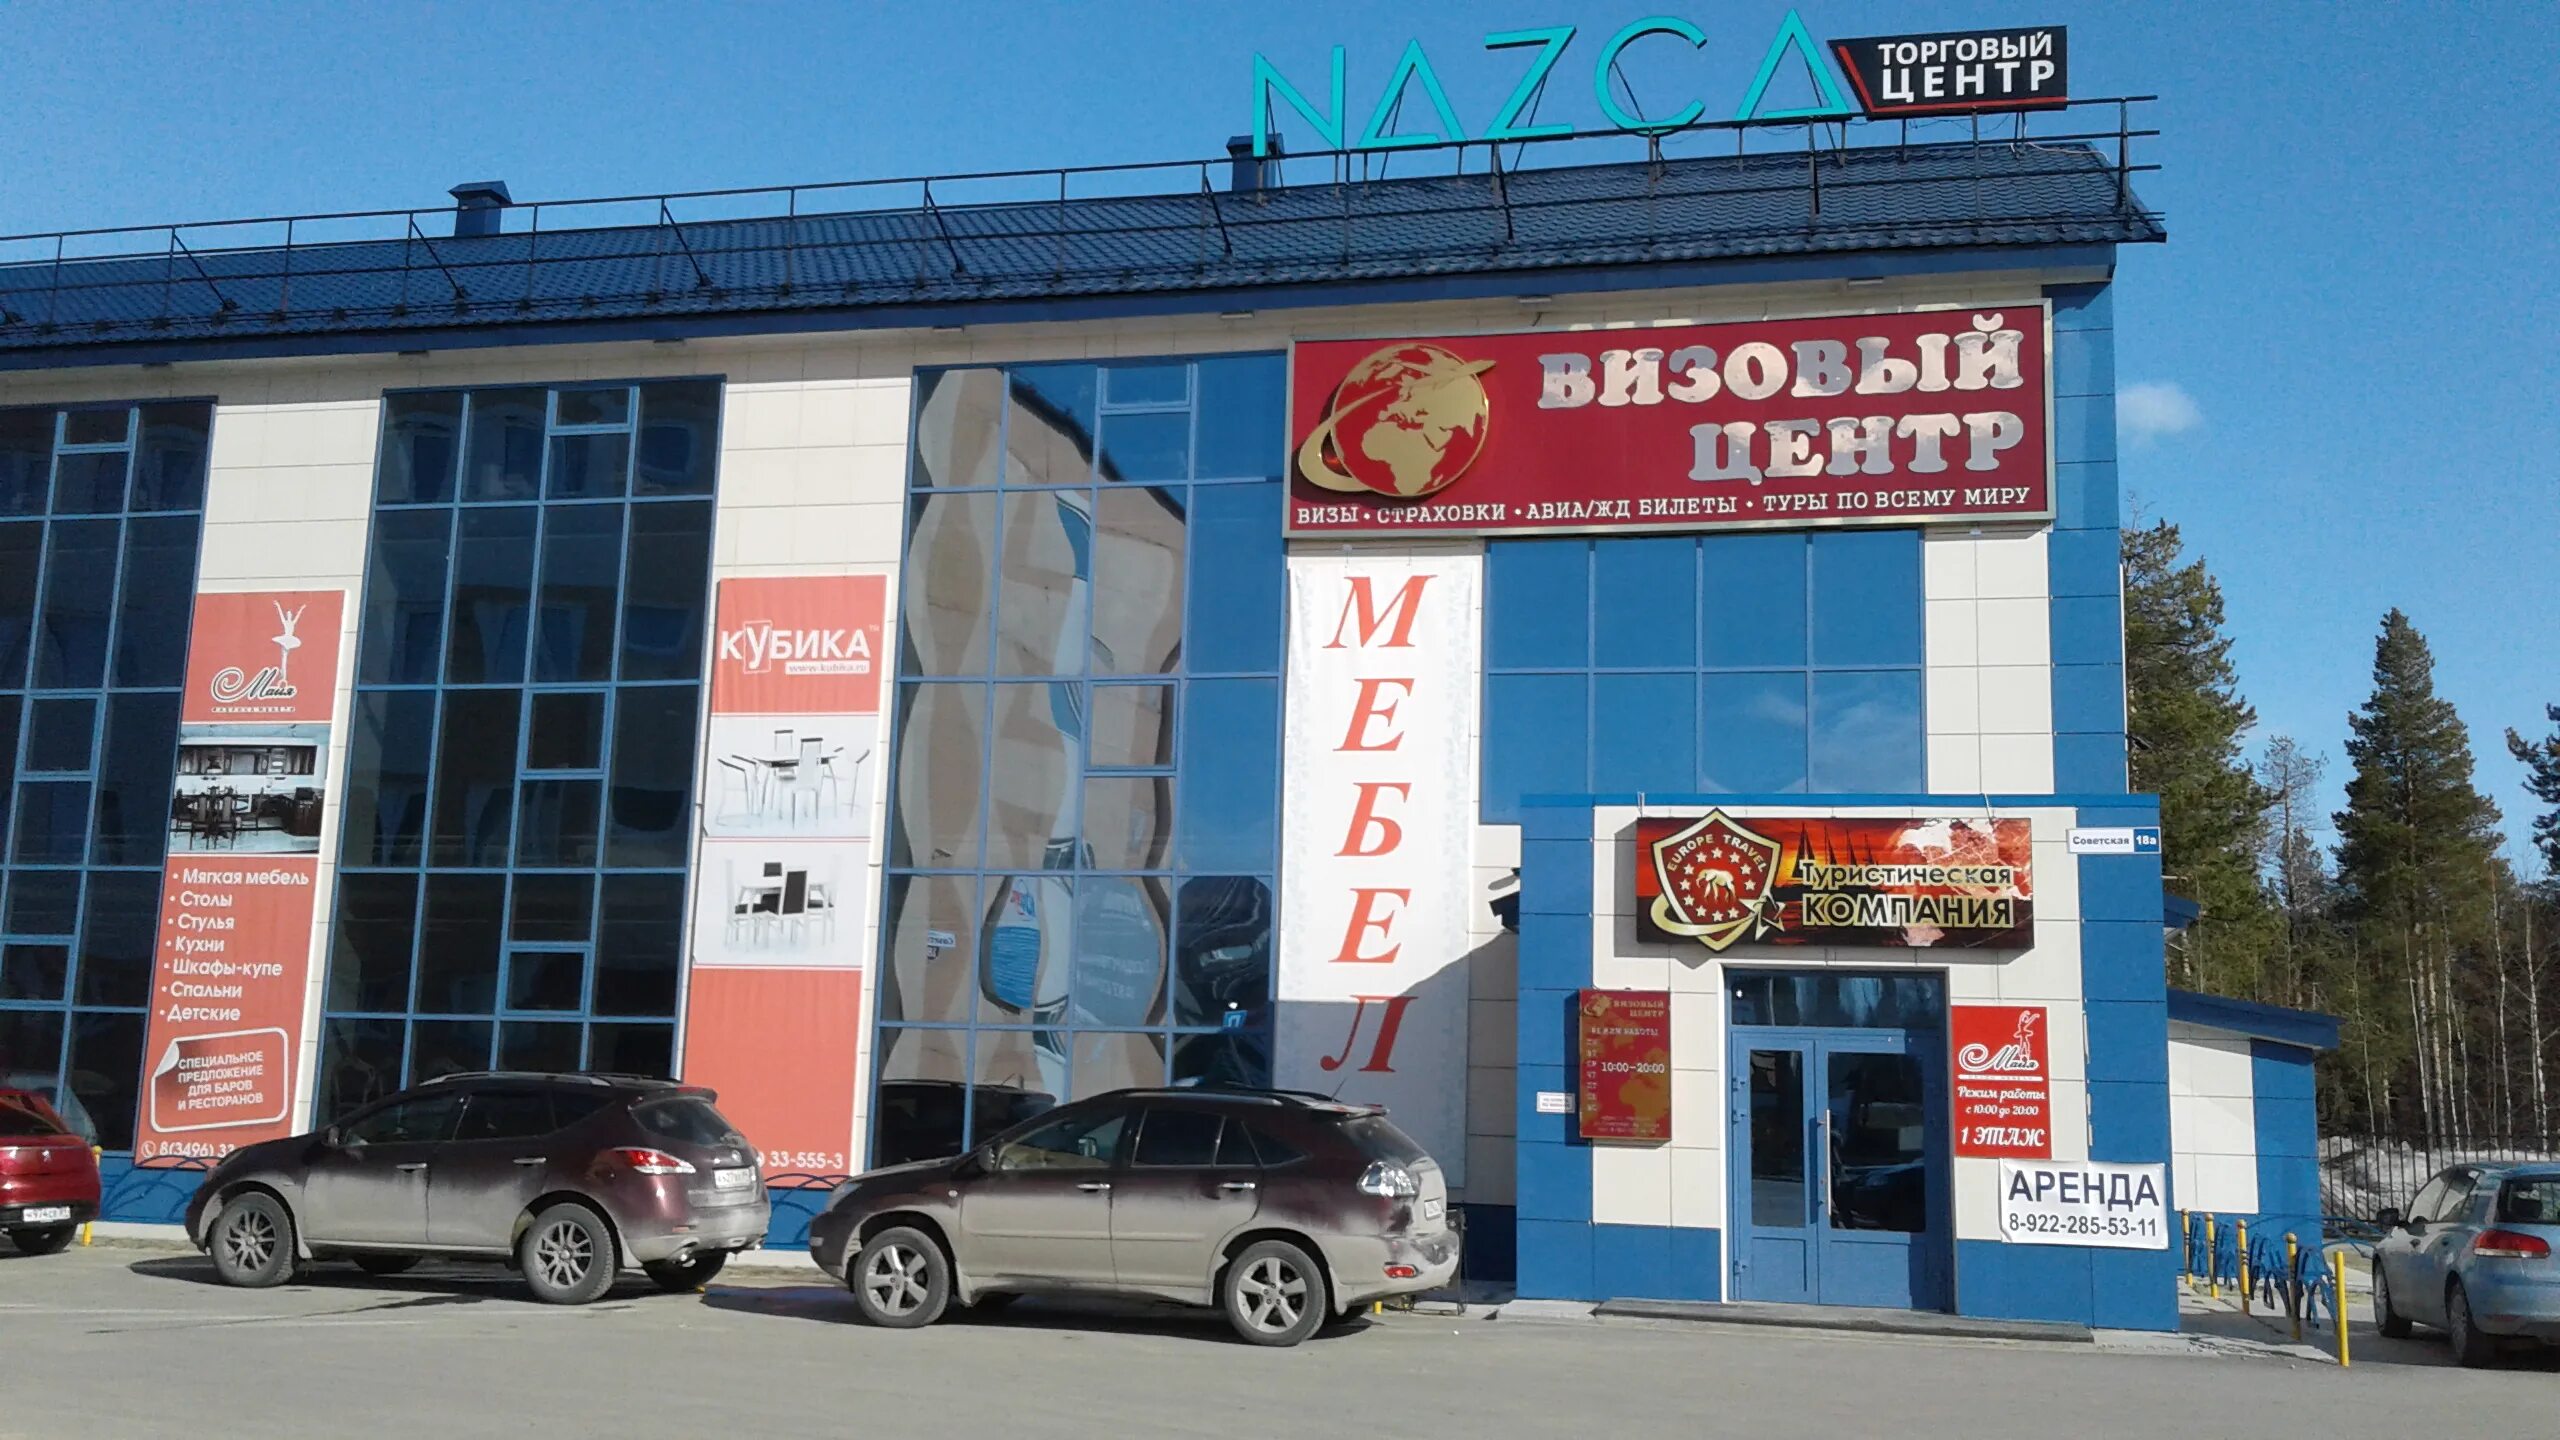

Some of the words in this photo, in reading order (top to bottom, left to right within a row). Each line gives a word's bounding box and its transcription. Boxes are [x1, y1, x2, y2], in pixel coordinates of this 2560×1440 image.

[1878, 31, 2052, 66] ТОРГОВЫЙ
[1253, 9, 1849, 157] NAZCA
[1882, 60, 2055, 103] ЦЕНТР
[1537, 313, 2024, 409] ВИЗОВЫЙ
[1687, 411, 2025, 485] ЦЕНТР
[1297, 507, 1358, 524] ВИЗЫ
[1377, 503, 1506, 523] СТРАХОВКИ
[1527, 499, 1630, 520] АВИА/ЖД
[1639, 496, 1737, 518] БИЛЕТЫ
[1763, 493, 1828, 512] ТУРЫ
[1836, 491, 1869, 509] ПО
[1875, 489, 1955, 509] ВСЕМУ
[1964, 487, 2030, 505] МИРУ
[1321, 575, 1437, 1107] МЕБЕЛ
[2072, 836, 2130, 845] Советская
[1667, 834, 1714, 872] EUROPE
[1723, 834, 1767, 873] TRAVEL
[182, 868, 242, 885] Мягкая
[246, 869, 310, 886] мебель
[1801, 861, 2012, 889] Туристическая
[180, 890, 233, 907] Столы
[1804, 896, 2013, 926] КОМПАНИЯ
[178, 913, 235, 932] Стулья
[175, 935, 225, 955] Кухни
[172, 958, 283, 979] Шкафы-купе
[170, 981, 242, 998] Спальни
[167, 1003, 241, 1023] Детские
[178, 1051, 264, 1070] СПЕЦИАЛЬНОЕ
[178, 1065, 264, 1083] ПРЕДЛОЖЕНИЕ
[187, 1084, 212, 1098] ДЛЯ
[214, 1080, 253, 1094] БАРОВ
[1957, 1086, 1997, 1099] Режим
[1999, 1088, 2046, 1104] работы
[177, 1100, 186, 1111] И
[188, 1093, 264, 1110] РЕСТОРАНОВ
[2012, 1105, 2039, 1116] 20:00
[1960, 1127, 1969, 1145] 1
[1973, 1127, 2046, 1147] ЭТАЖ
[159, 1141, 214, 1157] 8(3496)
[769, 1151, 843, 1169] 33-555-3
[2008, 1170, 2160, 1212] АРЕНДА
[2009, 1213, 2156, 1237] 8-922-285-53-11
